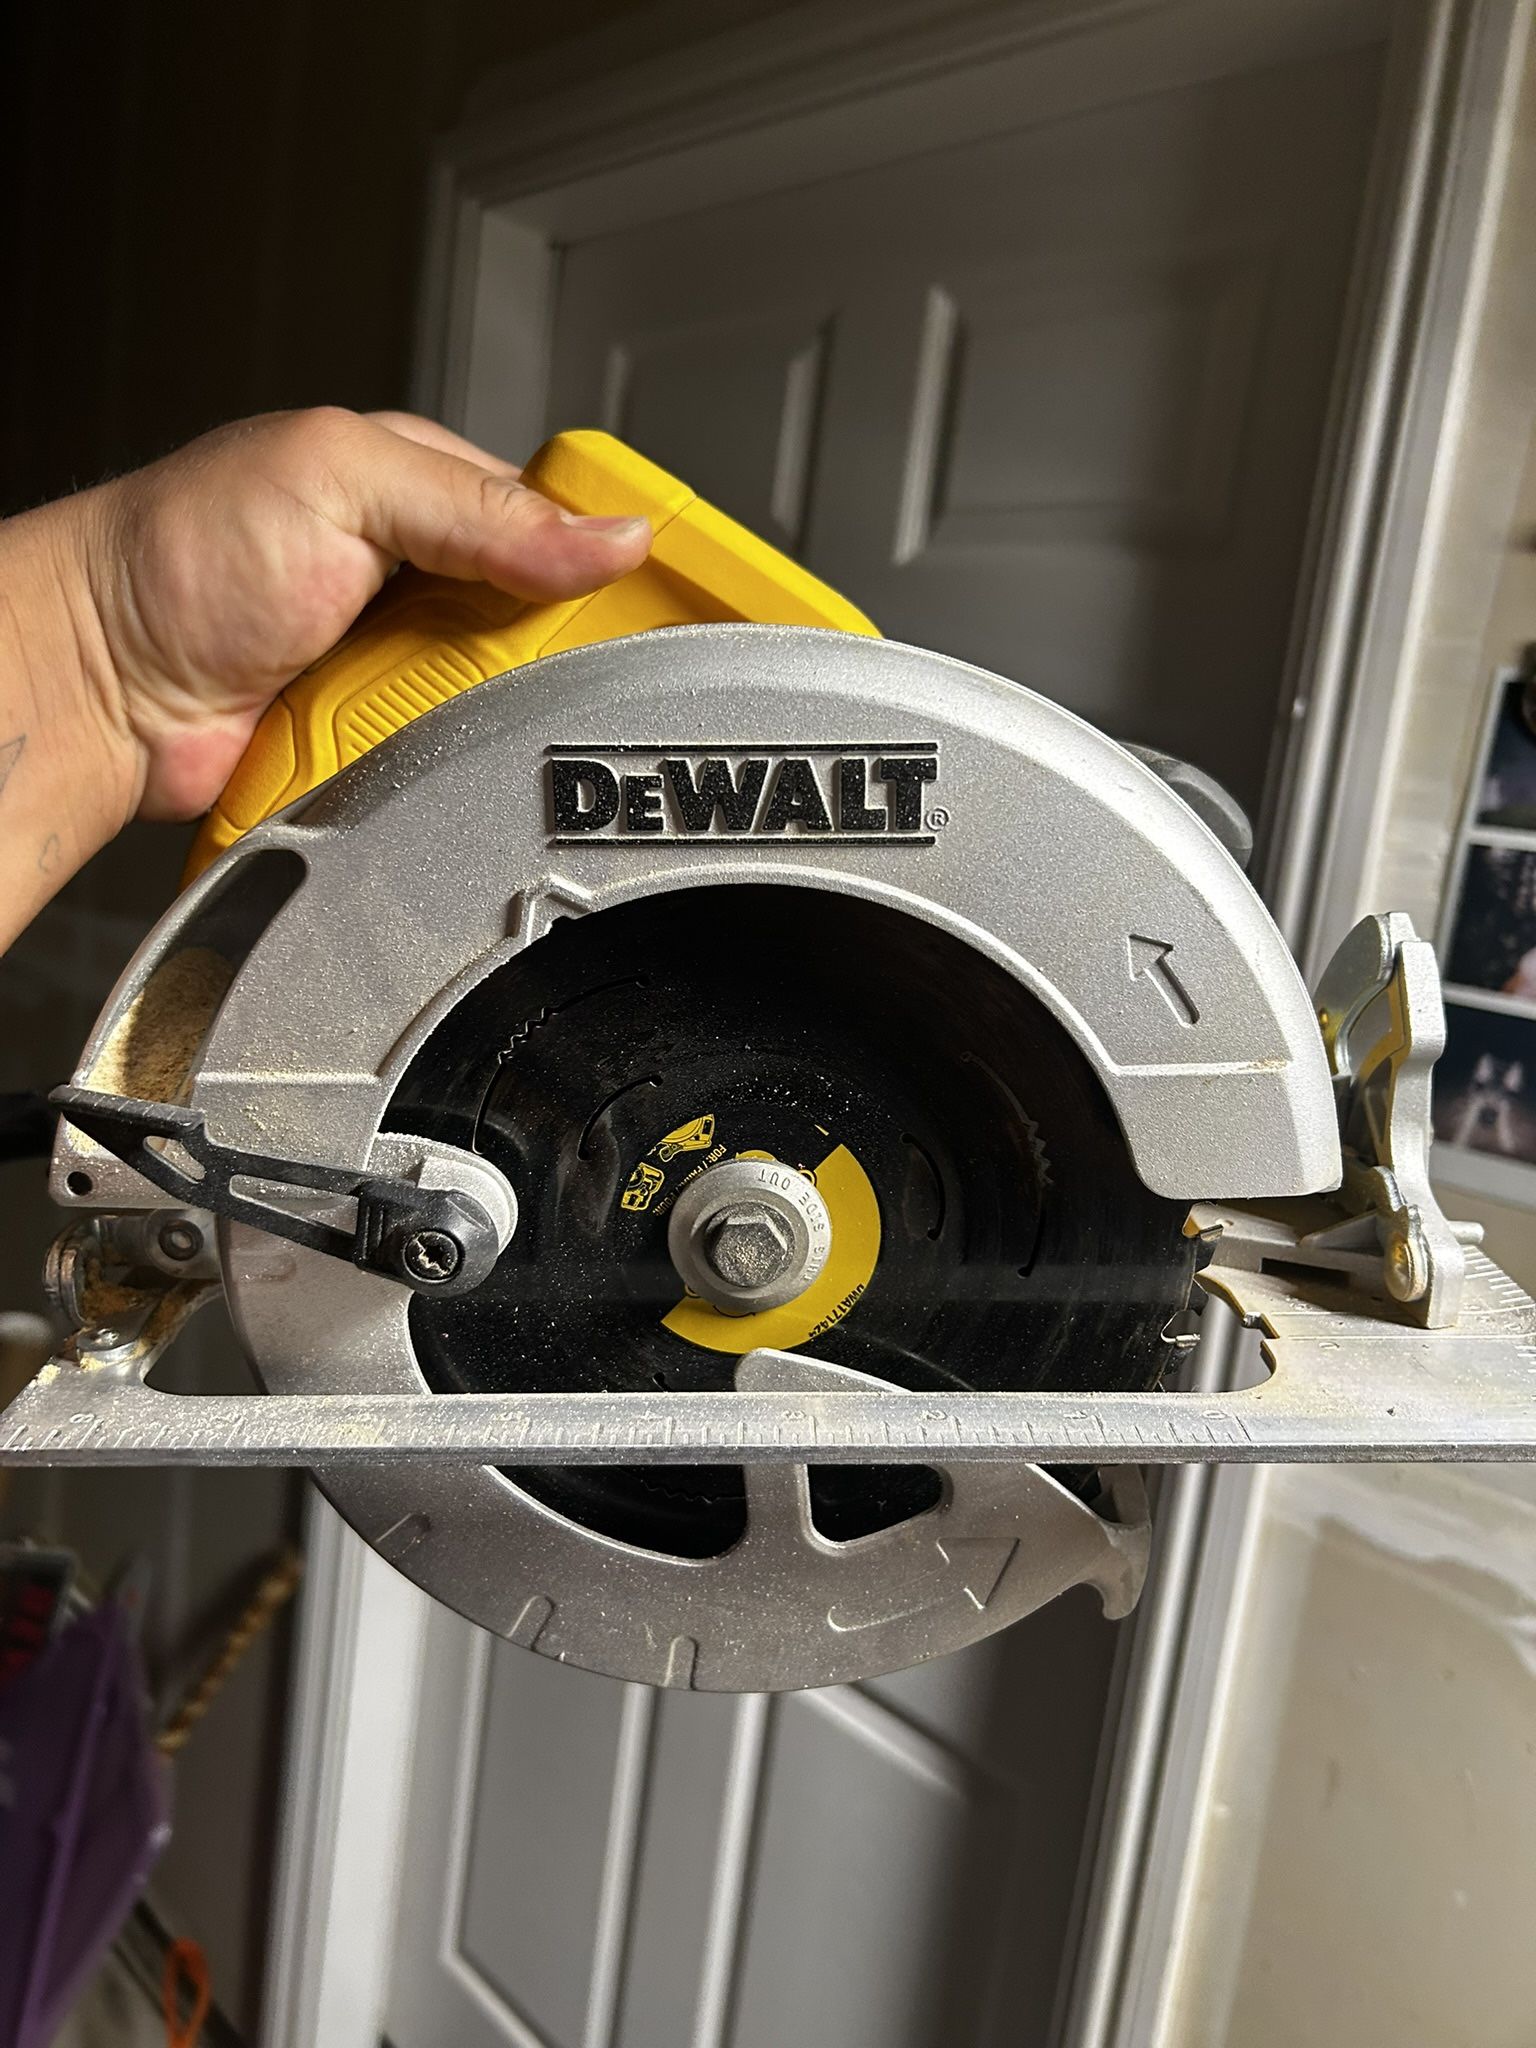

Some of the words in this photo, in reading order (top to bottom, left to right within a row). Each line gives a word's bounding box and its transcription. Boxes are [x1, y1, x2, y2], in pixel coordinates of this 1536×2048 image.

[758, 1168, 791, 1191] OUT
[798, 1192, 825, 1233] SIDE
[803, 1246, 826, 1281] THIS
